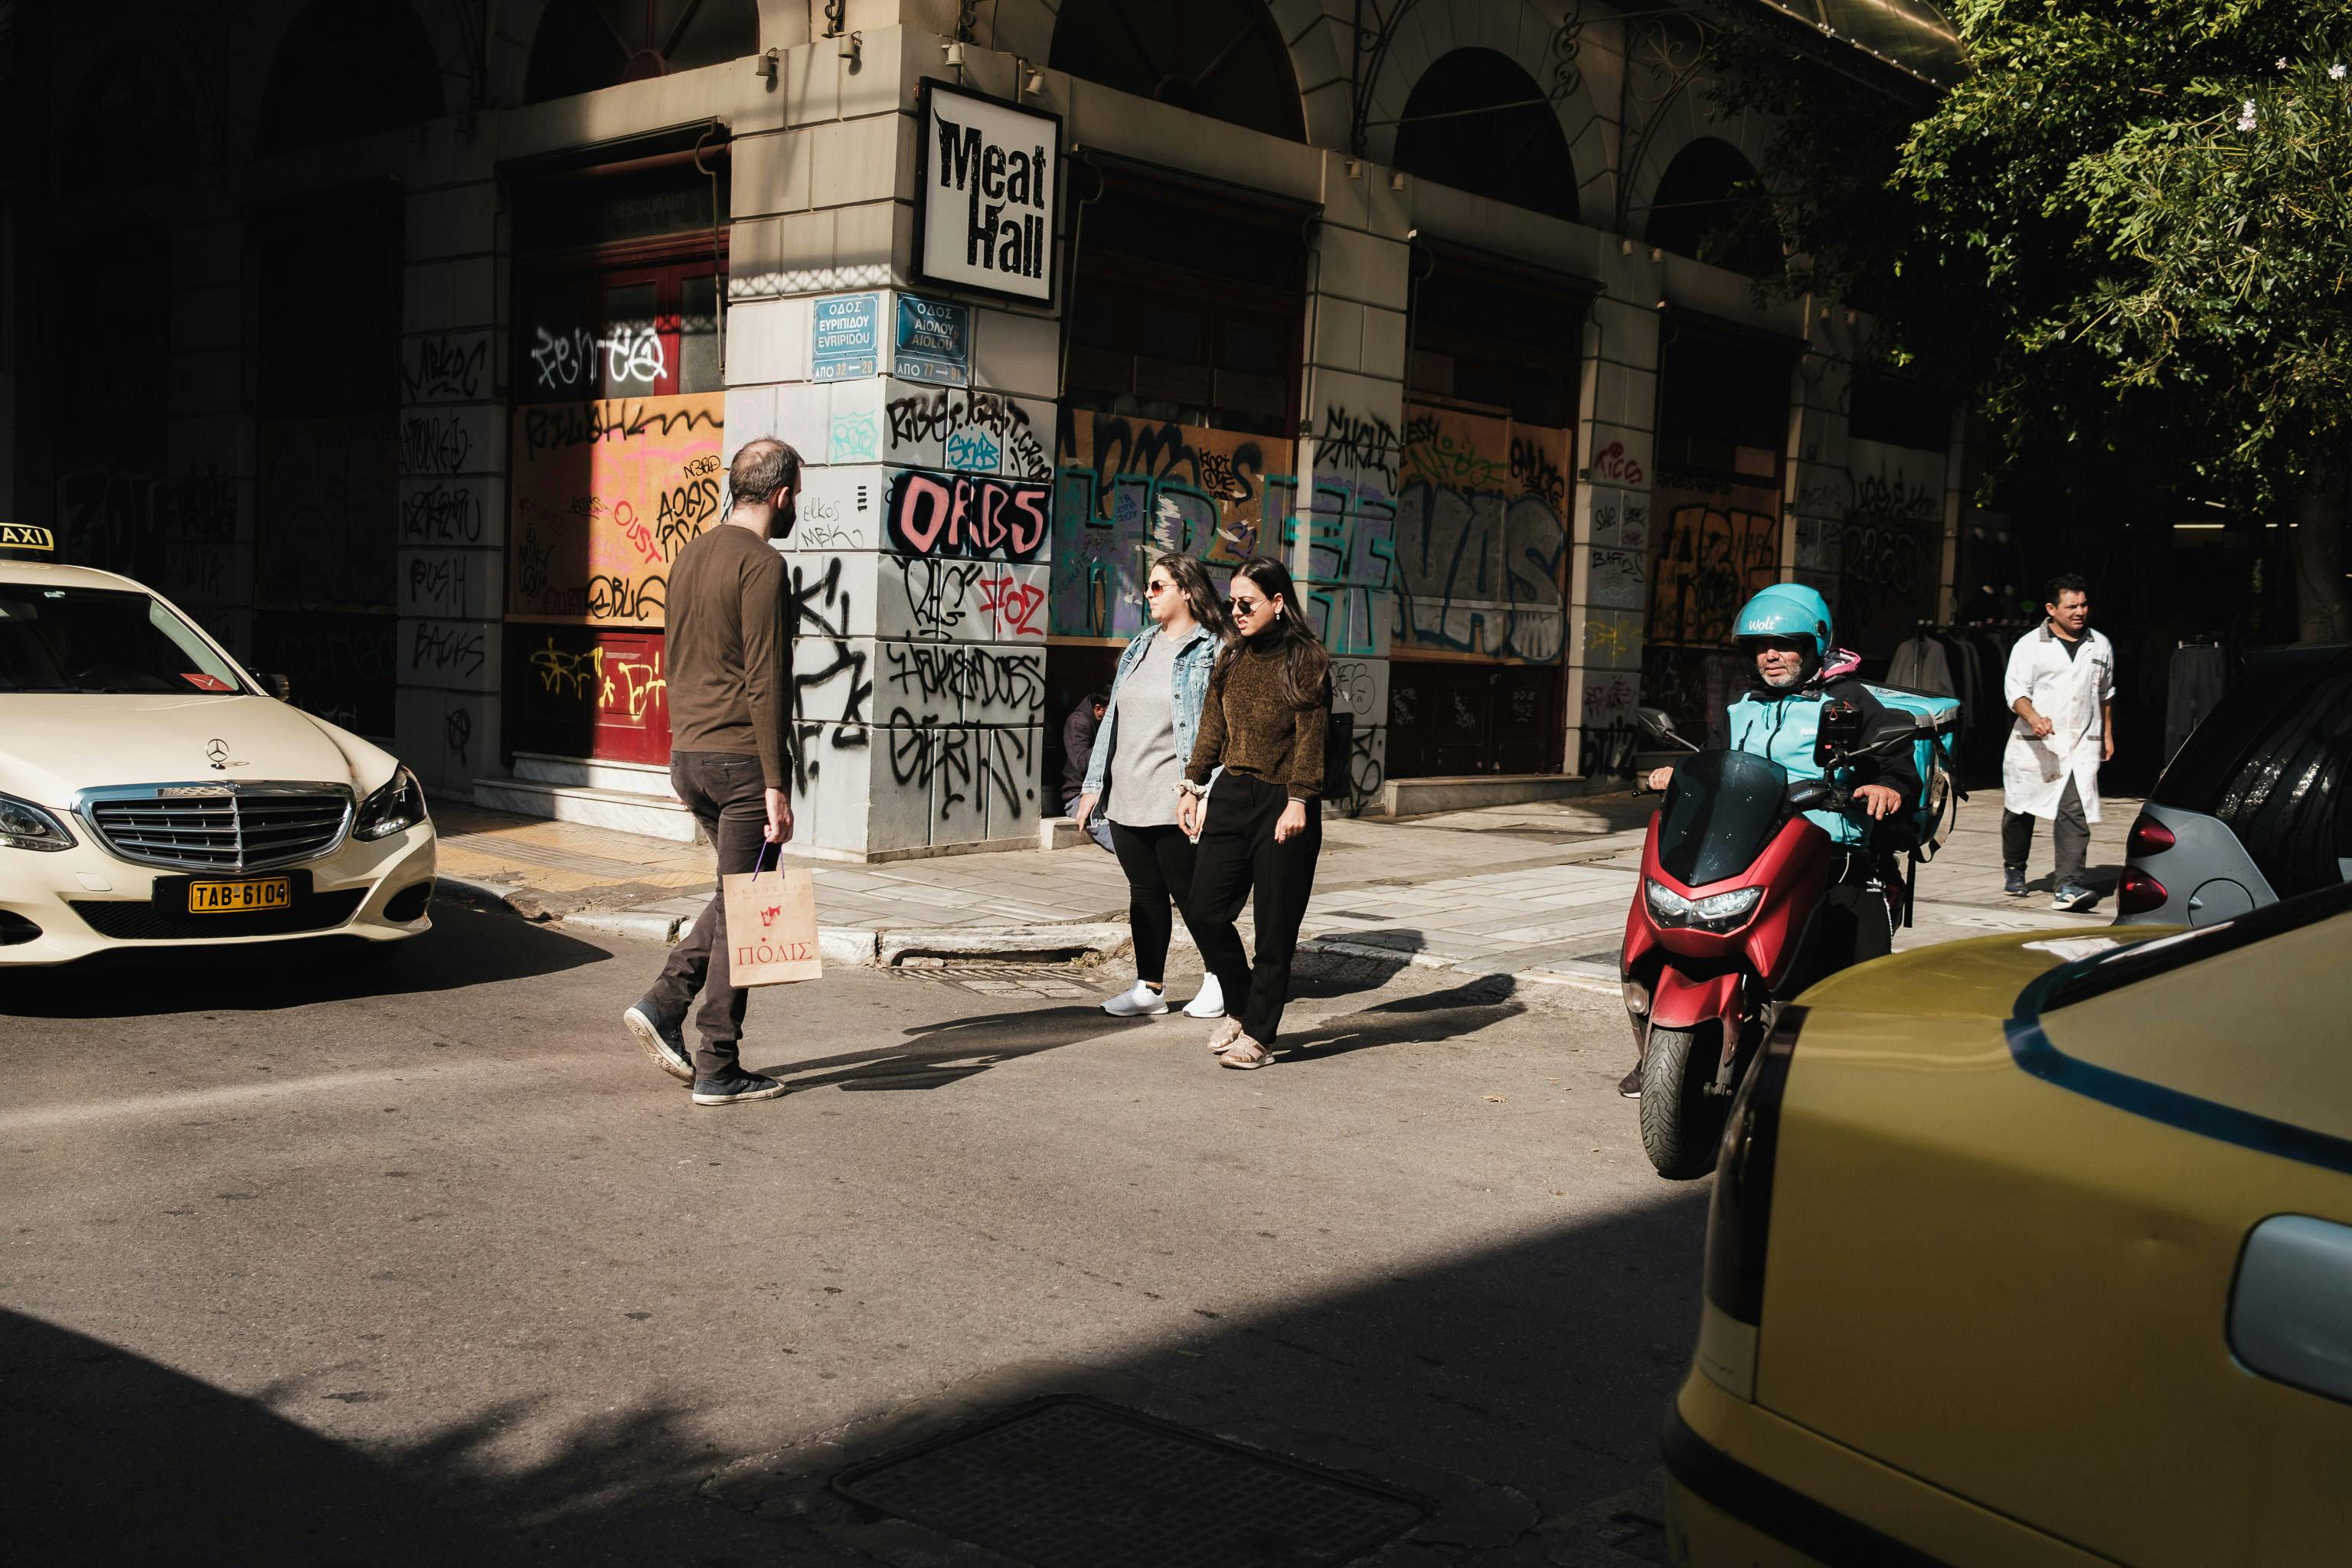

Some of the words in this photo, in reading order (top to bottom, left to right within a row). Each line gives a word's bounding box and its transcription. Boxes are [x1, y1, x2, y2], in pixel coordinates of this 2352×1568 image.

[933, 106, 1047, 211] Meat
[966, 195, 1044, 279] Hall
[829, 302, 861, 315] ΟΔΟΣ
[917, 303, 952, 318] ΟΔΟΣ
[820, 315, 870, 332] ΕΥΡΙΠΙΔΟΥ
[914, 318, 954, 335] ΑΙΟΛΟΥ
[818, 332, 870, 348] EVRIPIDOU
[912, 334, 952, 351] AIOLOU
[815, 367, 834, 378] ΑΠΟ
[836, 363, 847, 375] 32
[862, 361, 873, 374] 20
[897, 363, 920, 377] ΑΠΟ
[924, 364, 934, 377] 77
[1748, 616, 1776, 631] Wolt
[196, 884, 286, 906] TAB-6104
[737, 942, 813, 965] ΠΟΛΙΣ
